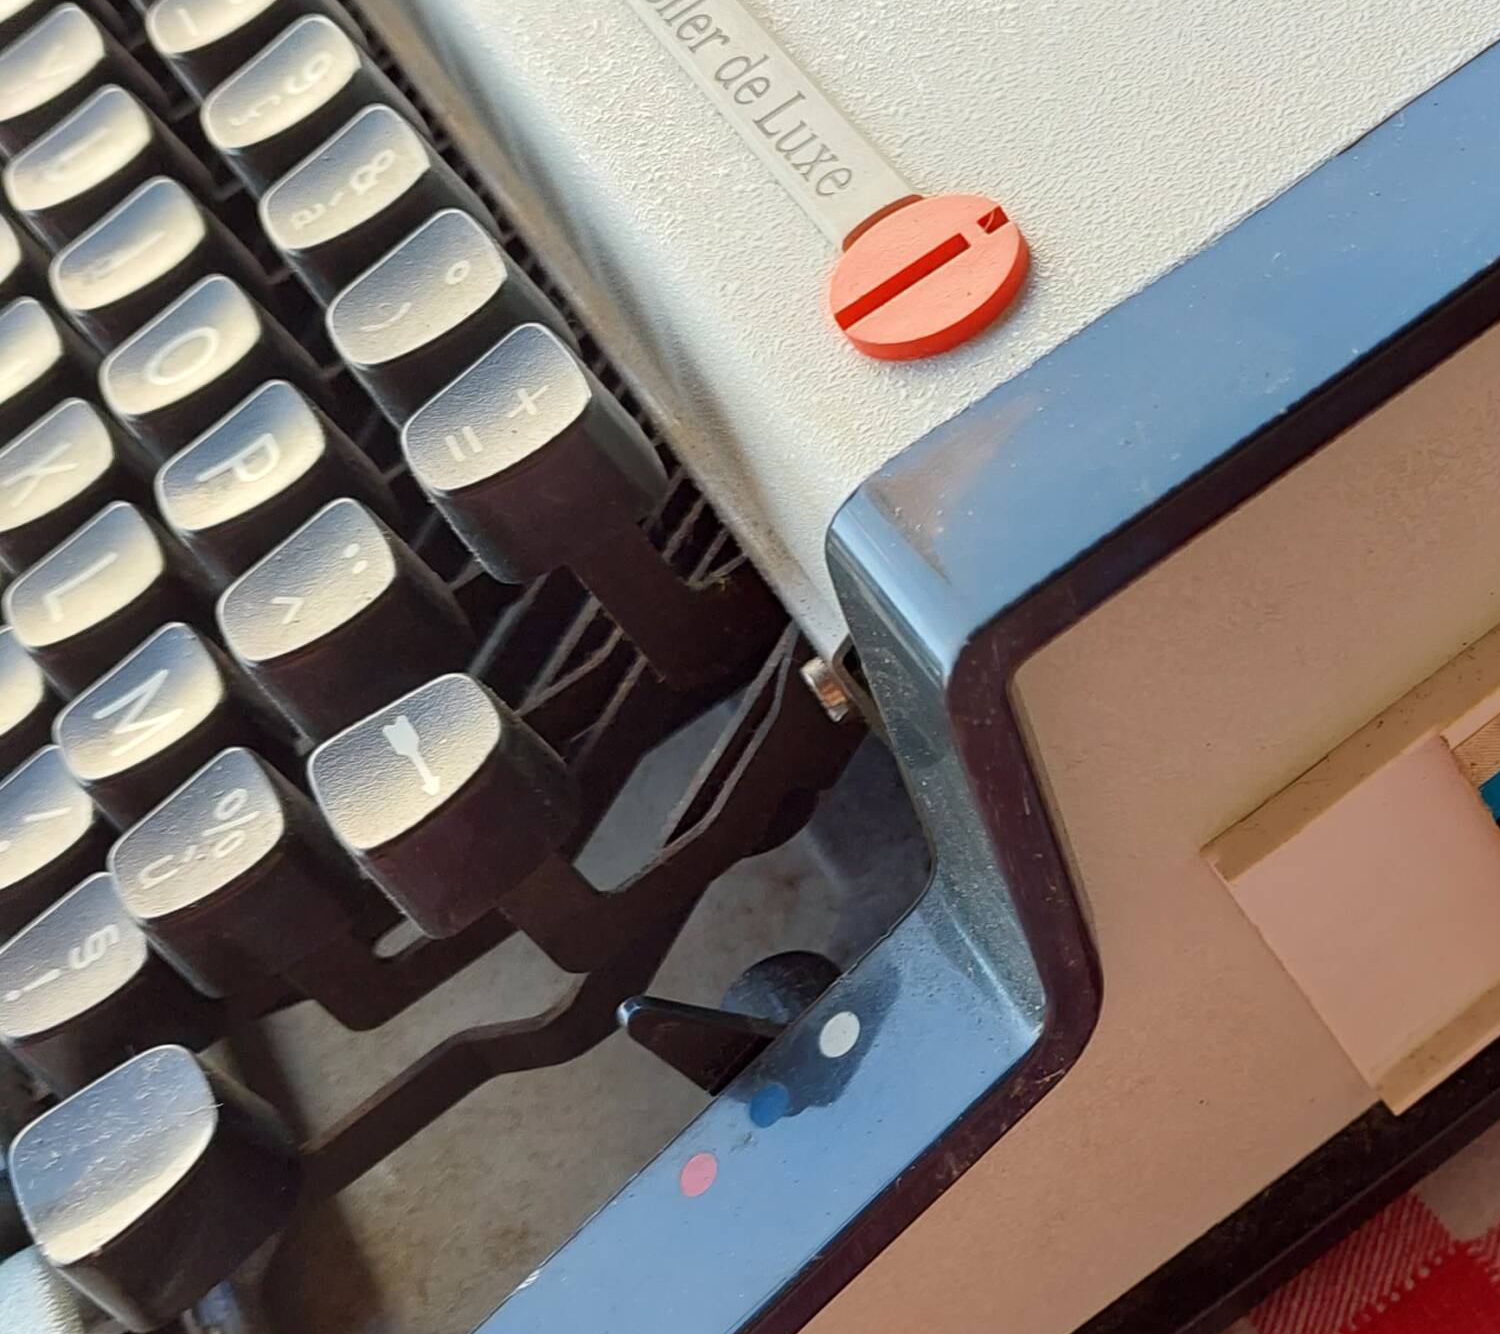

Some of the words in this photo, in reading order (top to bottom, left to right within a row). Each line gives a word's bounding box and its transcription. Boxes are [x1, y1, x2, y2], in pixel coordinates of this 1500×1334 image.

[282, 52, 332, 96] 9
[713, 53, 770, 105] de
[751, 89, 853, 197] Luxe
[350, 148, 397, 195] &
[146, 326, 220, 385] O
[2, 441, 80, 508] K
[195, 432, 280, 483] P
[42, 551, 119, 622] L
[92, 668, 184, 758] M
[202, 788, 260, 858] %
